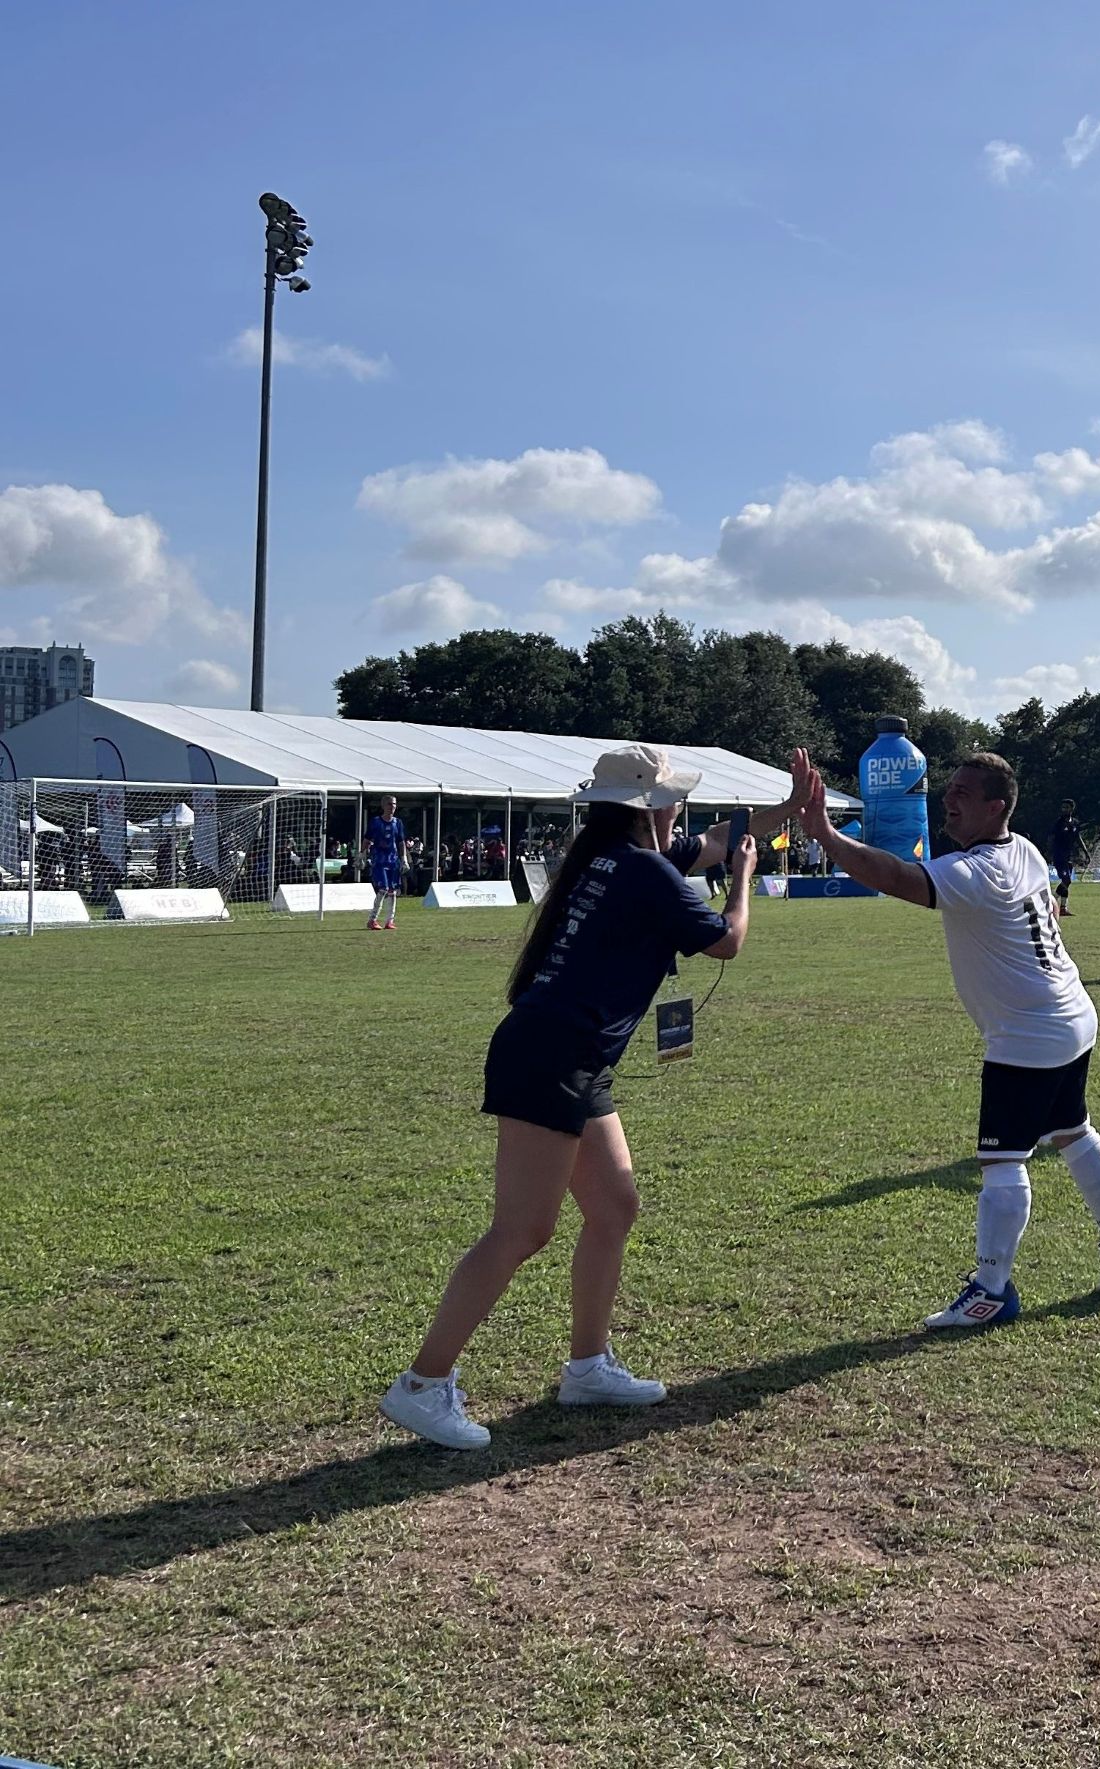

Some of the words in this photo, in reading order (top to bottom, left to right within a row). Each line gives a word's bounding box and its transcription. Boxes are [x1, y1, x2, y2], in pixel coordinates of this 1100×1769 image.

[868, 757, 925, 772] POWER
[868, 771, 902, 786] ADE
[590, 856, 617, 873] EER
[980, 1137, 999, 1146] JAKO
